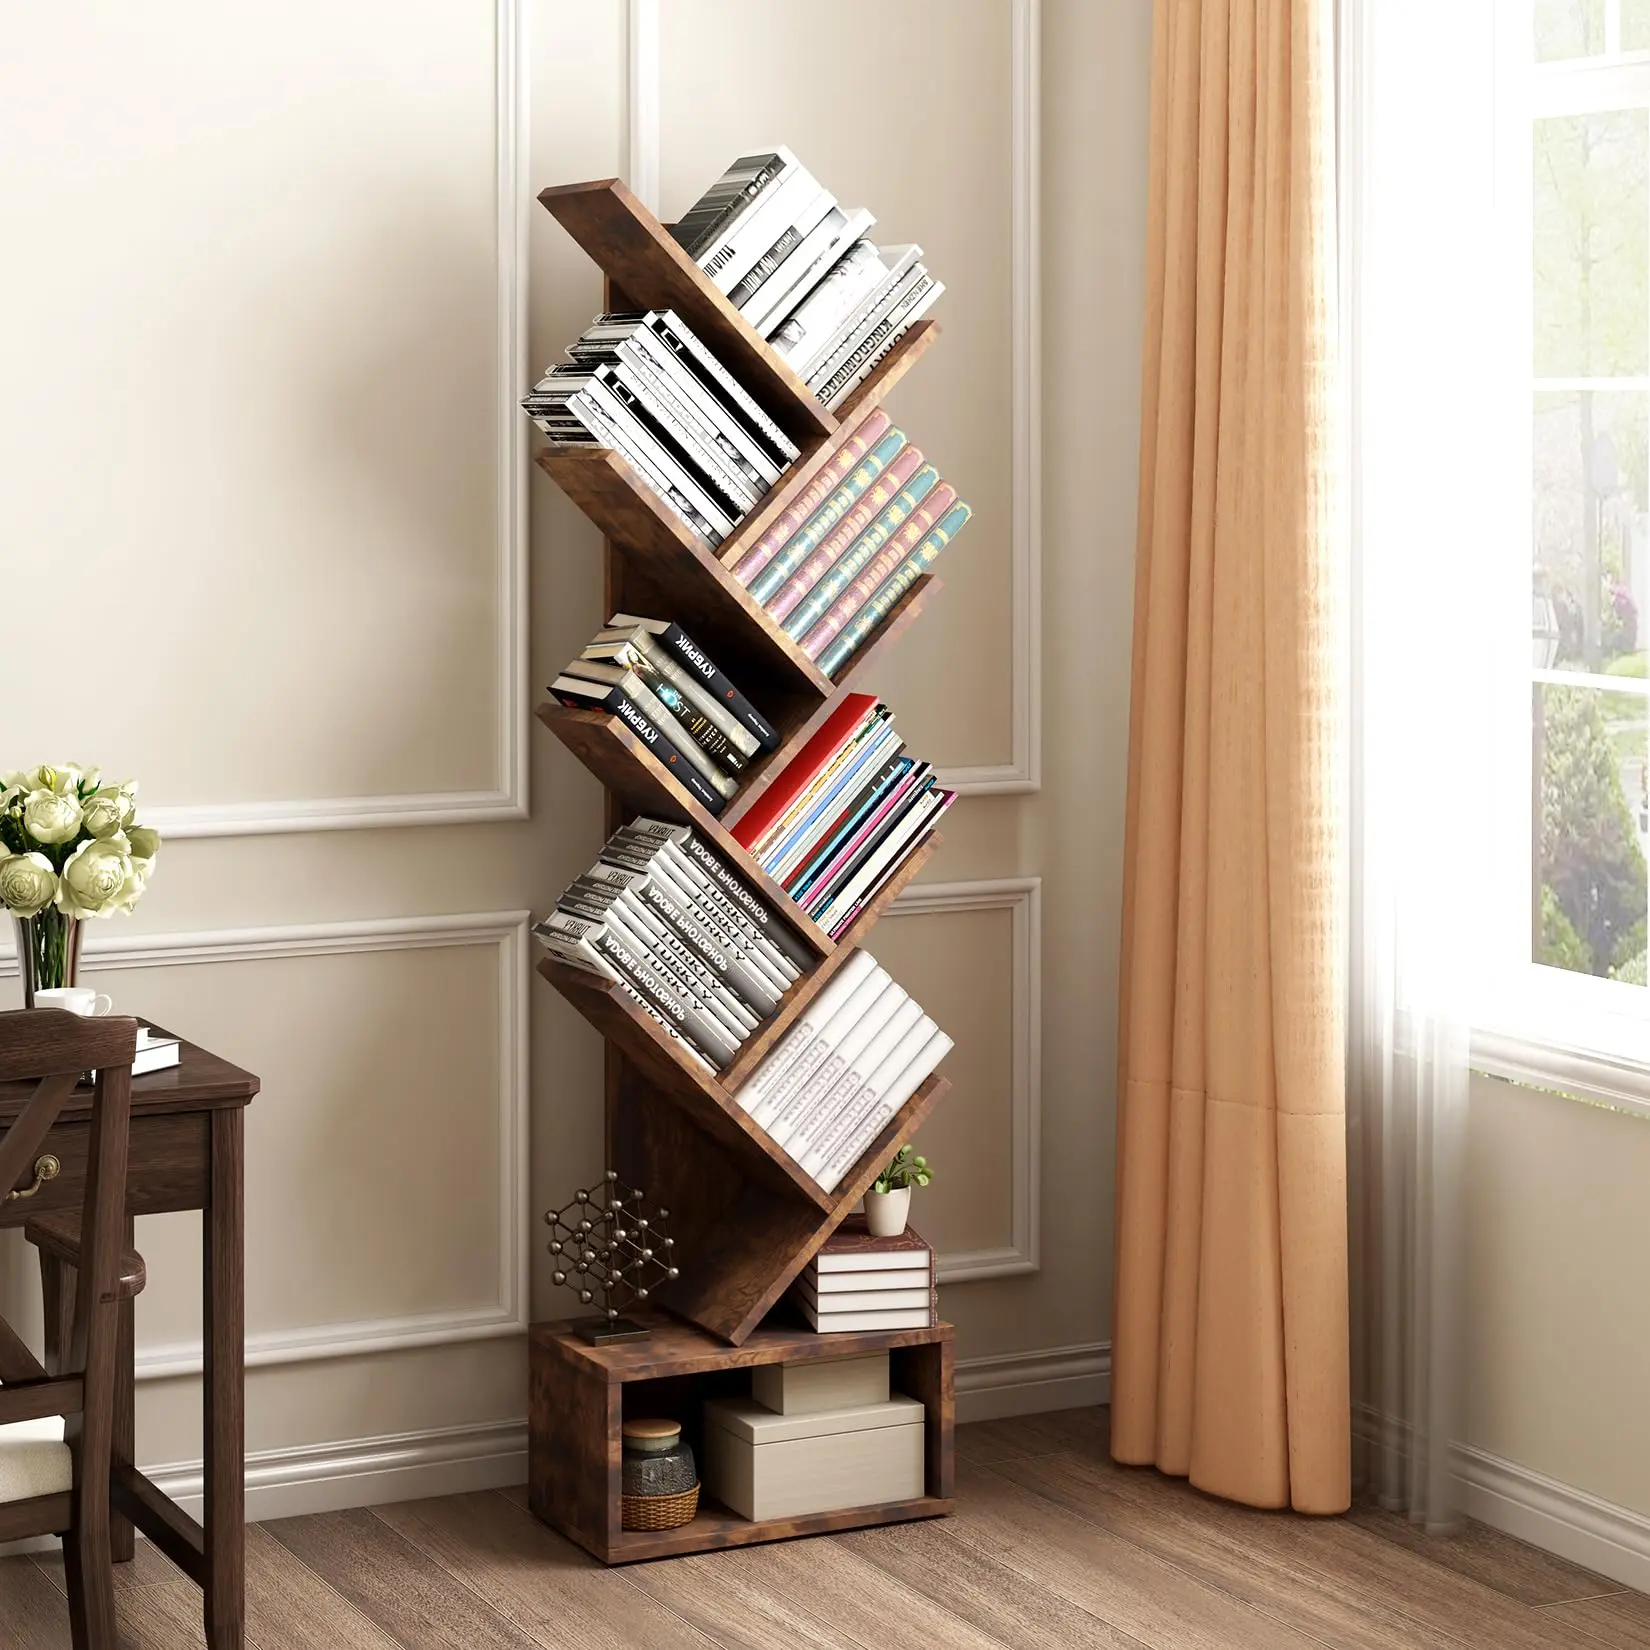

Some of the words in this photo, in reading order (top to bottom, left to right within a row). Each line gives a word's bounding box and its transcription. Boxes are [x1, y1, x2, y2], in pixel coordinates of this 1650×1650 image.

[901, 279, 929, 310] SHENZHEN
[675, 634, 716, 679] КУБРИК
[617, 699, 659, 744] КУБРИК
[656, 683, 691, 717] HOST
[686, 902, 745, 961] TURKEY
[695, 891, 754, 950] TURKEY
[703, 881, 763, 941] TURKEY
[644, 952, 703, 1010] TURKEY
[653, 942, 712, 1000] TURKEY
[662, 931, 721, 989] TURKEY
